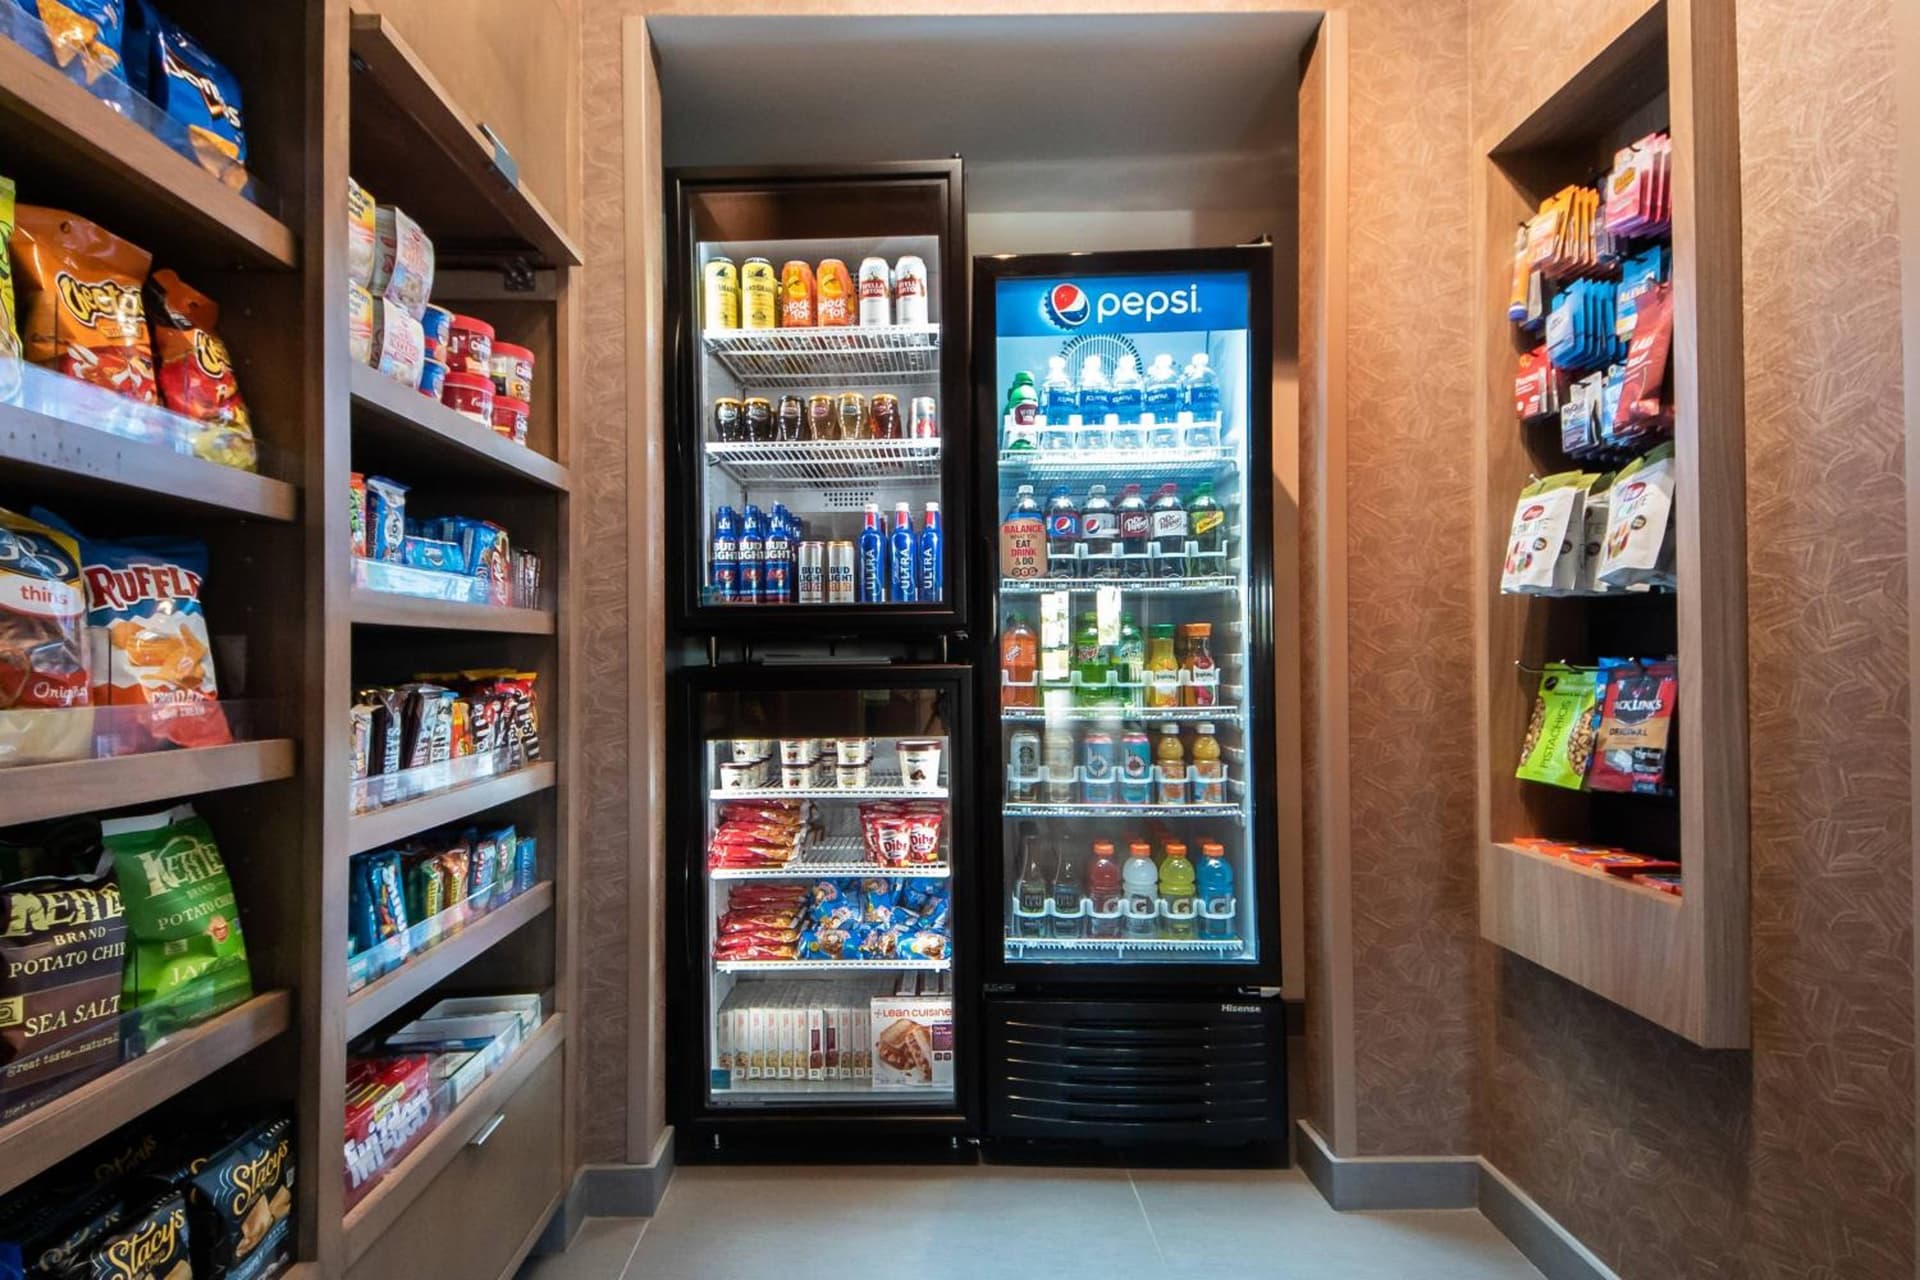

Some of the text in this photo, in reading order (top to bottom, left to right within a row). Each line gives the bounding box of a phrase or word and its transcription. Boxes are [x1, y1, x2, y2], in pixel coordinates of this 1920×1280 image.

[1097, 283, 1199, 324] pepsi
[1003, 524, 1043, 534] BALANCE
[1010, 548, 1037, 557] DRINK
[1015, 539, 1031, 549] EAT
[865, 549, 877, 590] ULTRA
[900, 548, 912, 589] ULTRA
[923, 547, 934, 589] ULTRA
[1022, 556, 1034, 565] DO
[53, 926, 107, 947] BRAND
[8, 950, 88, 979] POTATO
[23, 994, 121, 1038] SEA SALT
[1221, 1003, 1262, 1013] Hisense
